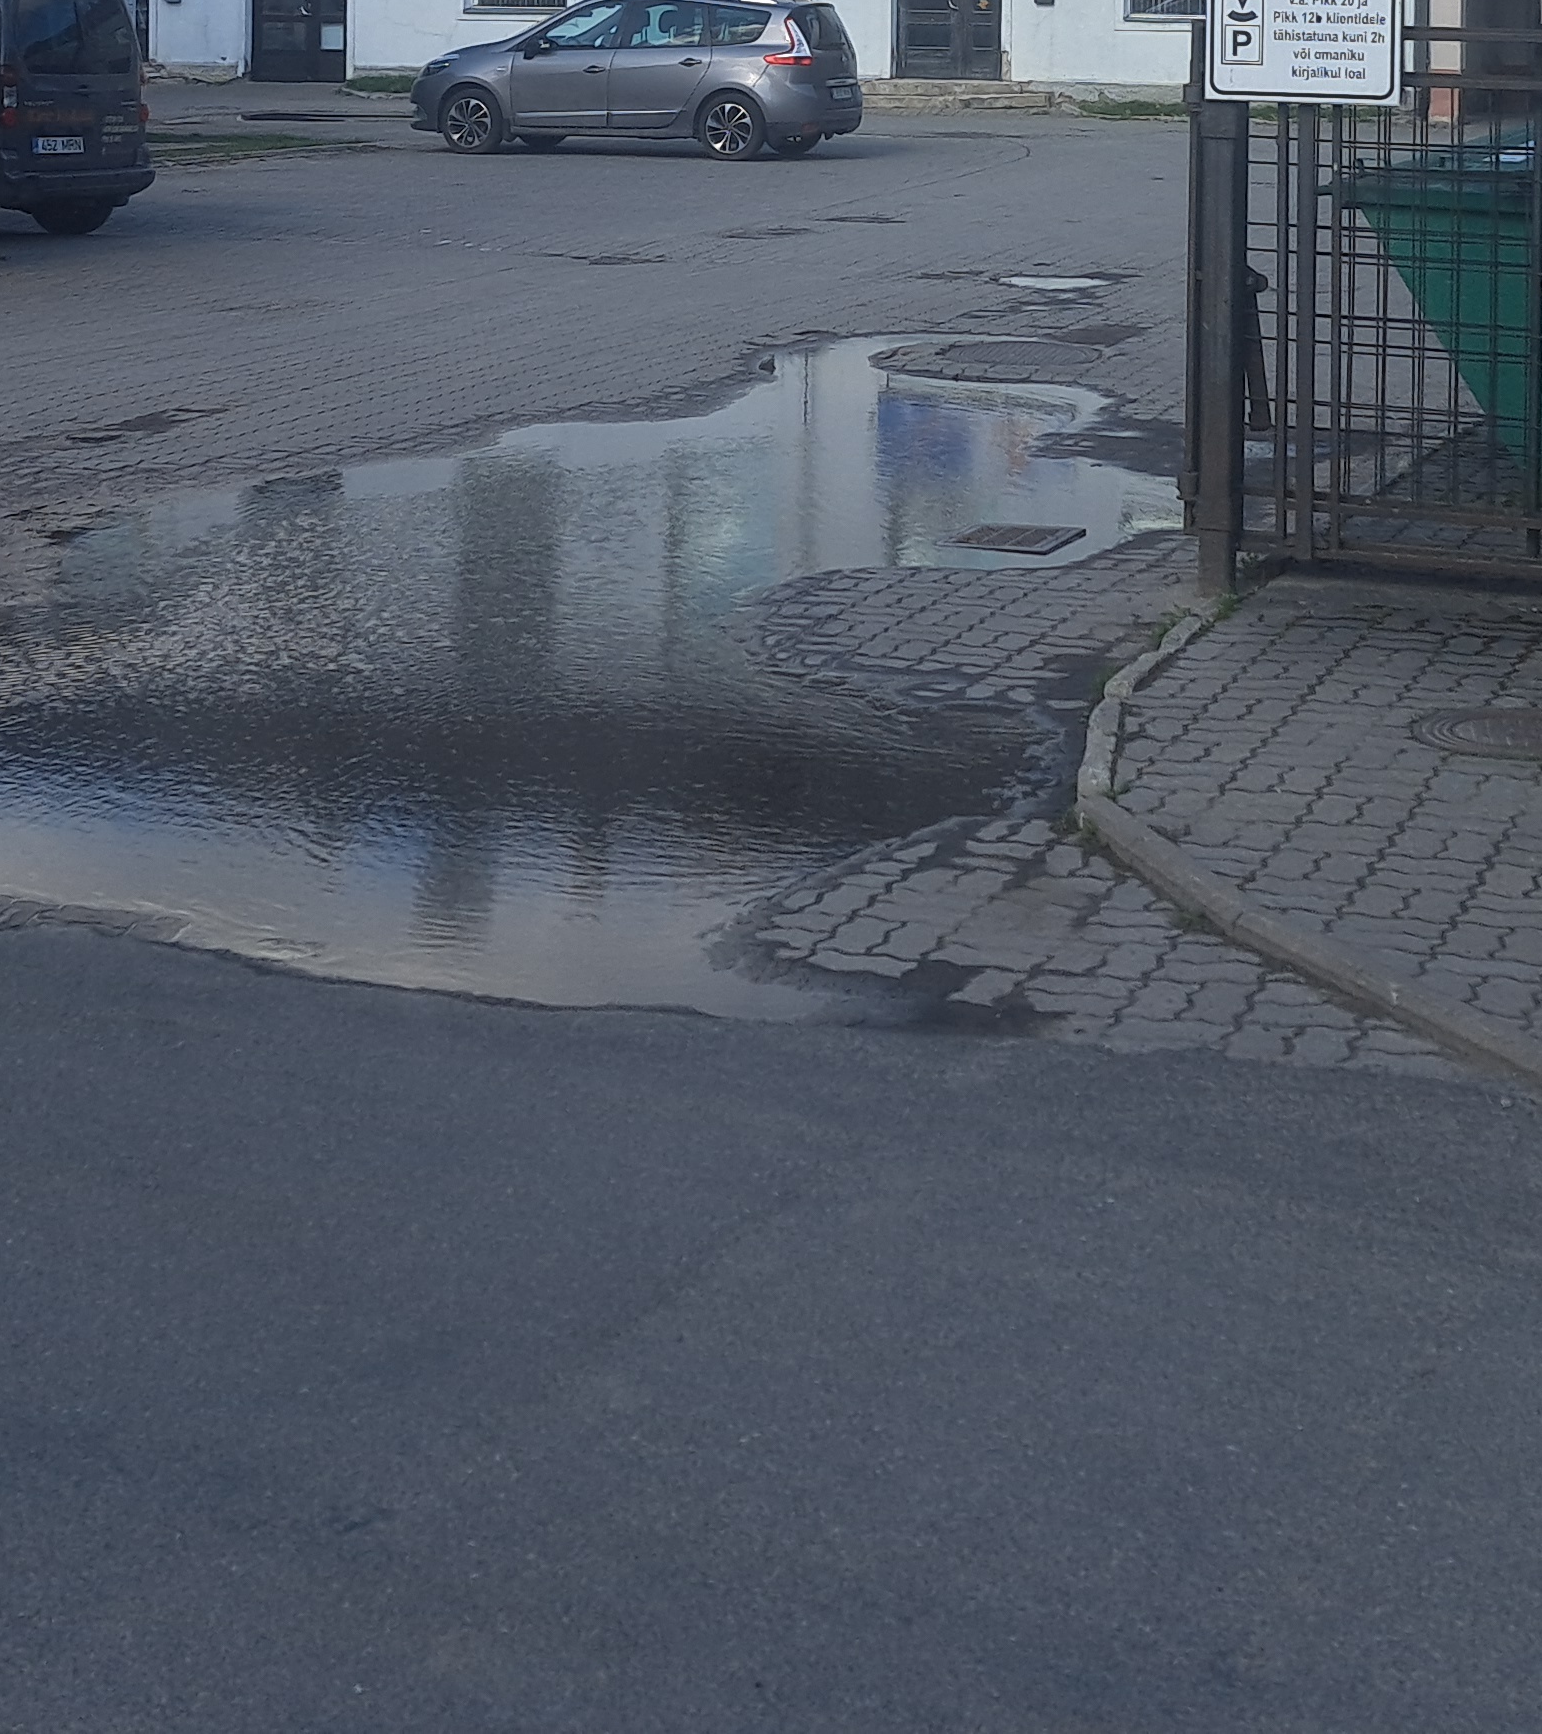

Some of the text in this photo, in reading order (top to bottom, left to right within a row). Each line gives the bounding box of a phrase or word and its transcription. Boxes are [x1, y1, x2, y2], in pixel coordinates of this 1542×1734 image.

[1273, 11, 1298, 23] Pikk
[1326, 12, 1386, 25] klientidele
[1233, 30, 1252, 56] P
[1274, 29, 1385, 43] tähistatuna kuni 2h
[1293, 48, 1365, 61] või omaniku
[1291, 66, 1366, 80] kirjalikul loal
